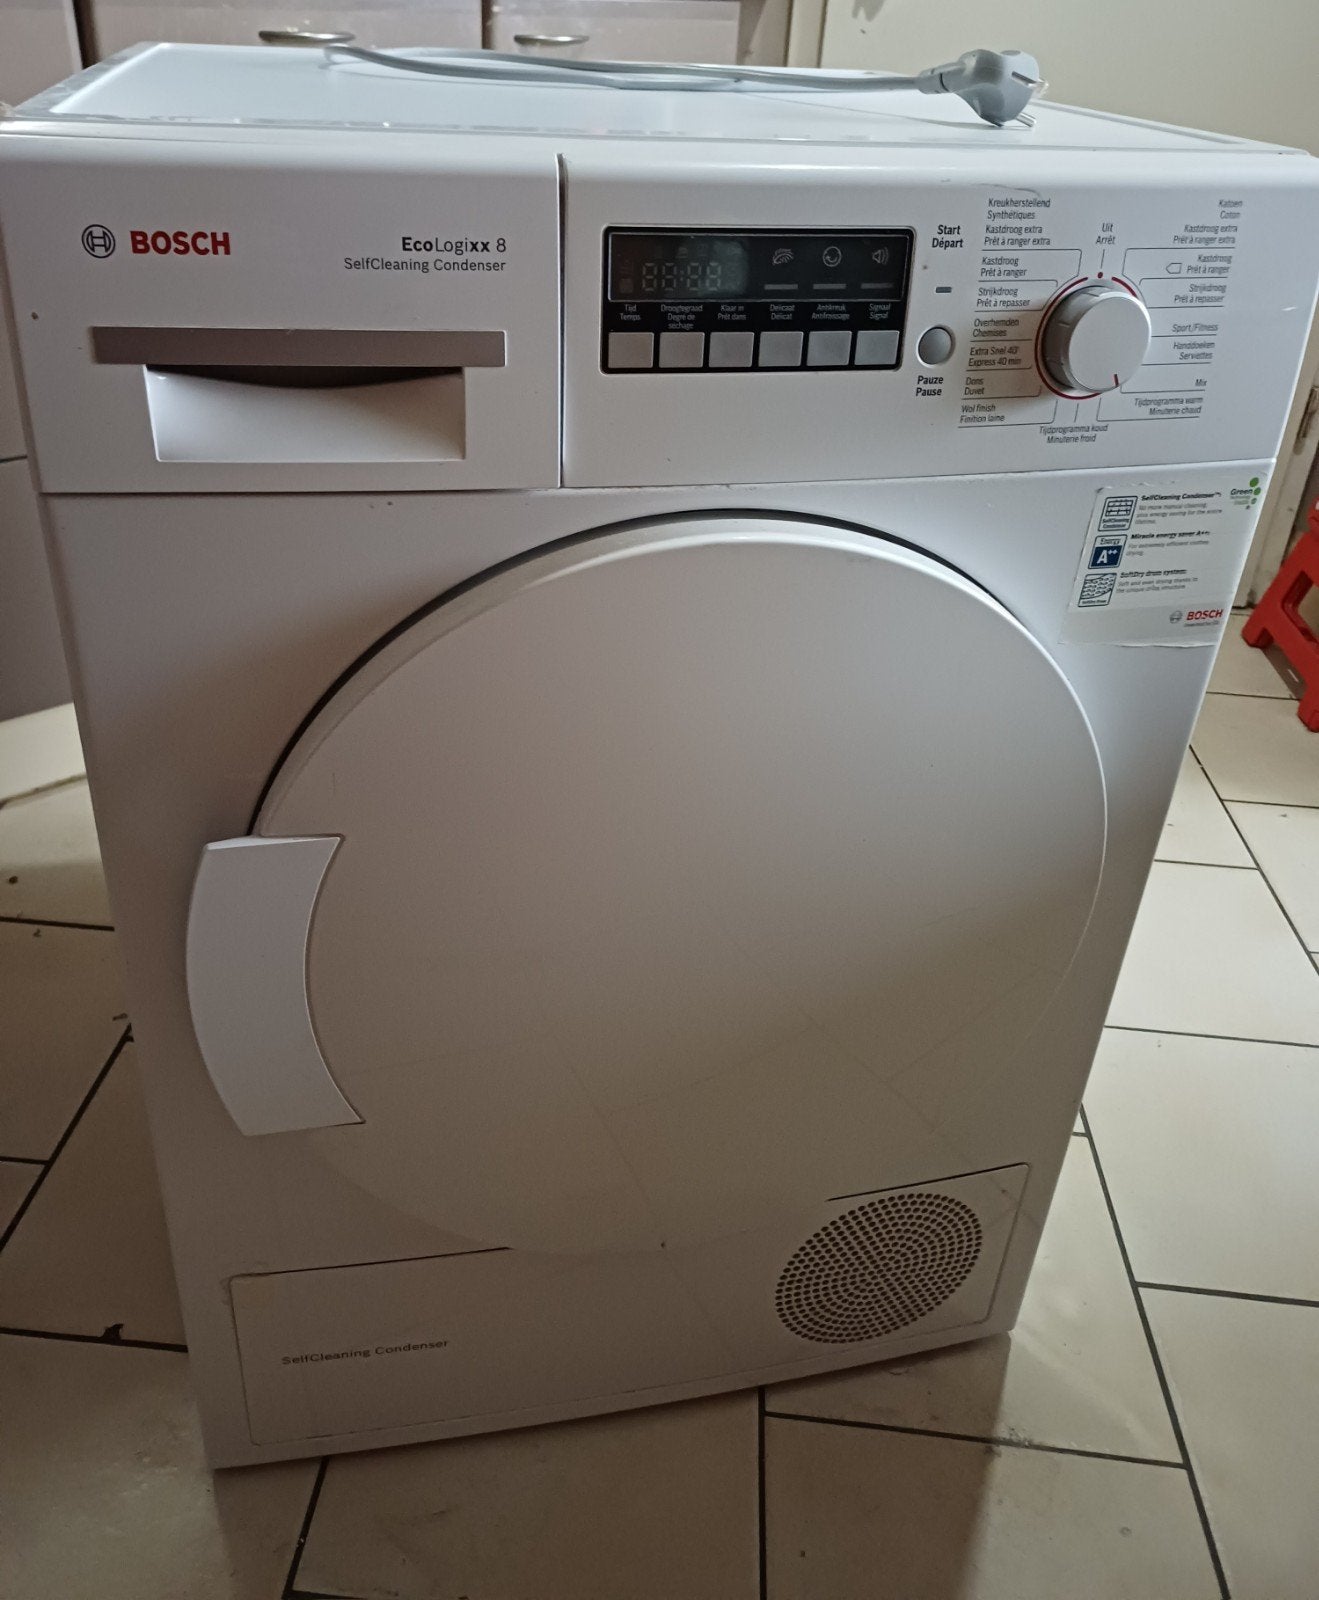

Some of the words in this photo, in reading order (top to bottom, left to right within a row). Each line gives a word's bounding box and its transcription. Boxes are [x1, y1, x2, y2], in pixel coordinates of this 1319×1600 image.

[988, 198, 1050, 208] Kreukherstellend
[987, 210, 1035, 221] Synthétiques
[937, 225, 961, 235] Start
[985, 225, 1022, 235] Kastdroog
[1024, 225, 1043, 233] extra
[1101, 223, 1113, 232] Uit
[1184, 224, 1219, 234] Kastdroog
[130, 230, 231, 255] BOSCH
[932, 237, 963, 250] Départ
[984, 236, 1000, 246] Prêt
[1007, 238, 1031, 247] ranger
[1032, 237, 1050, 245] extra
[1095, 235, 1116, 245] Arrêt
[1173, 235, 1188, 244] Prêt
[1194, 237, 1217, 246] ranger
[401, 236, 490, 255] EcoLogixx
[496, 237, 507, 252] 8
[982, 256, 1019, 267] Kastdroog
[1197, 254, 1232, 264] Kastdroog
[344, 258, 430, 273] SelfCleaning
[434, 259, 506, 271] Condenser
[1187, 265, 1200, 274] Prêt
[1207, 266, 1230, 275] ranger
[980, 267, 996, 277] Prêt
[1006, 269, 1027, 278] ranger
[978, 287, 1018, 298] Strijkdroog
[976, 298, 992, 307] Prêt
[999, 299, 1030, 309] repasser
[1174, 295, 1188, 303] Prêt
[1195, 296, 1225, 304] repasser
[721, 304, 736, 312] Klaar
[869, 303, 891, 312] Signaal
[620, 313, 641, 321] Temps
[869, 311, 889, 320] Signal
[974, 318, 1019, 327] Overhemden
[1172, 323, 1218, 332] Sport/Fitness
[972, 328, 1007, 337] Chemises
[1173, 341, 1215, 350] Handdoeken
[970, 347, 989, 356] Extra
[990, 346, 1006, 355] Snel
[968, 357, 996, 367] Express
[997, 357, 1007, 366] 40
[1008, 356, 1021, 365] min
[917, 375, 944, 385] Pauze
[966, 376, 984, 385] Dons
[1195, 379, 1207, 387] Mix
[915, 387, 943, 397] Pause
[964, 386, 985, 395] Duvet
[962, 404, 975, 413] Wol
[976, 403, 996, 412] finish
[1181, 405, 1203, 414] chaud
[960, 415, 987, 424] Finition
[988, 414, 1006, 422] laine
[1039, 425, 1090, 435] Tijdprogramma
[1091, 424, 1109, 432] koud
[1047, 434, 1079, 443] Minuterie
[1080, 433, 1097, 442] froid
[1230, 488, 1253, 496] Green
[1156, 532, 1177, 540] energy
[1100, 537, 1121, 546] Energy
[1186, 609, 1224, 621] BOSCH
[281, 1349, 371, 1365] SelfCleaning
[375, 1340, 448, 1355] Condenser
